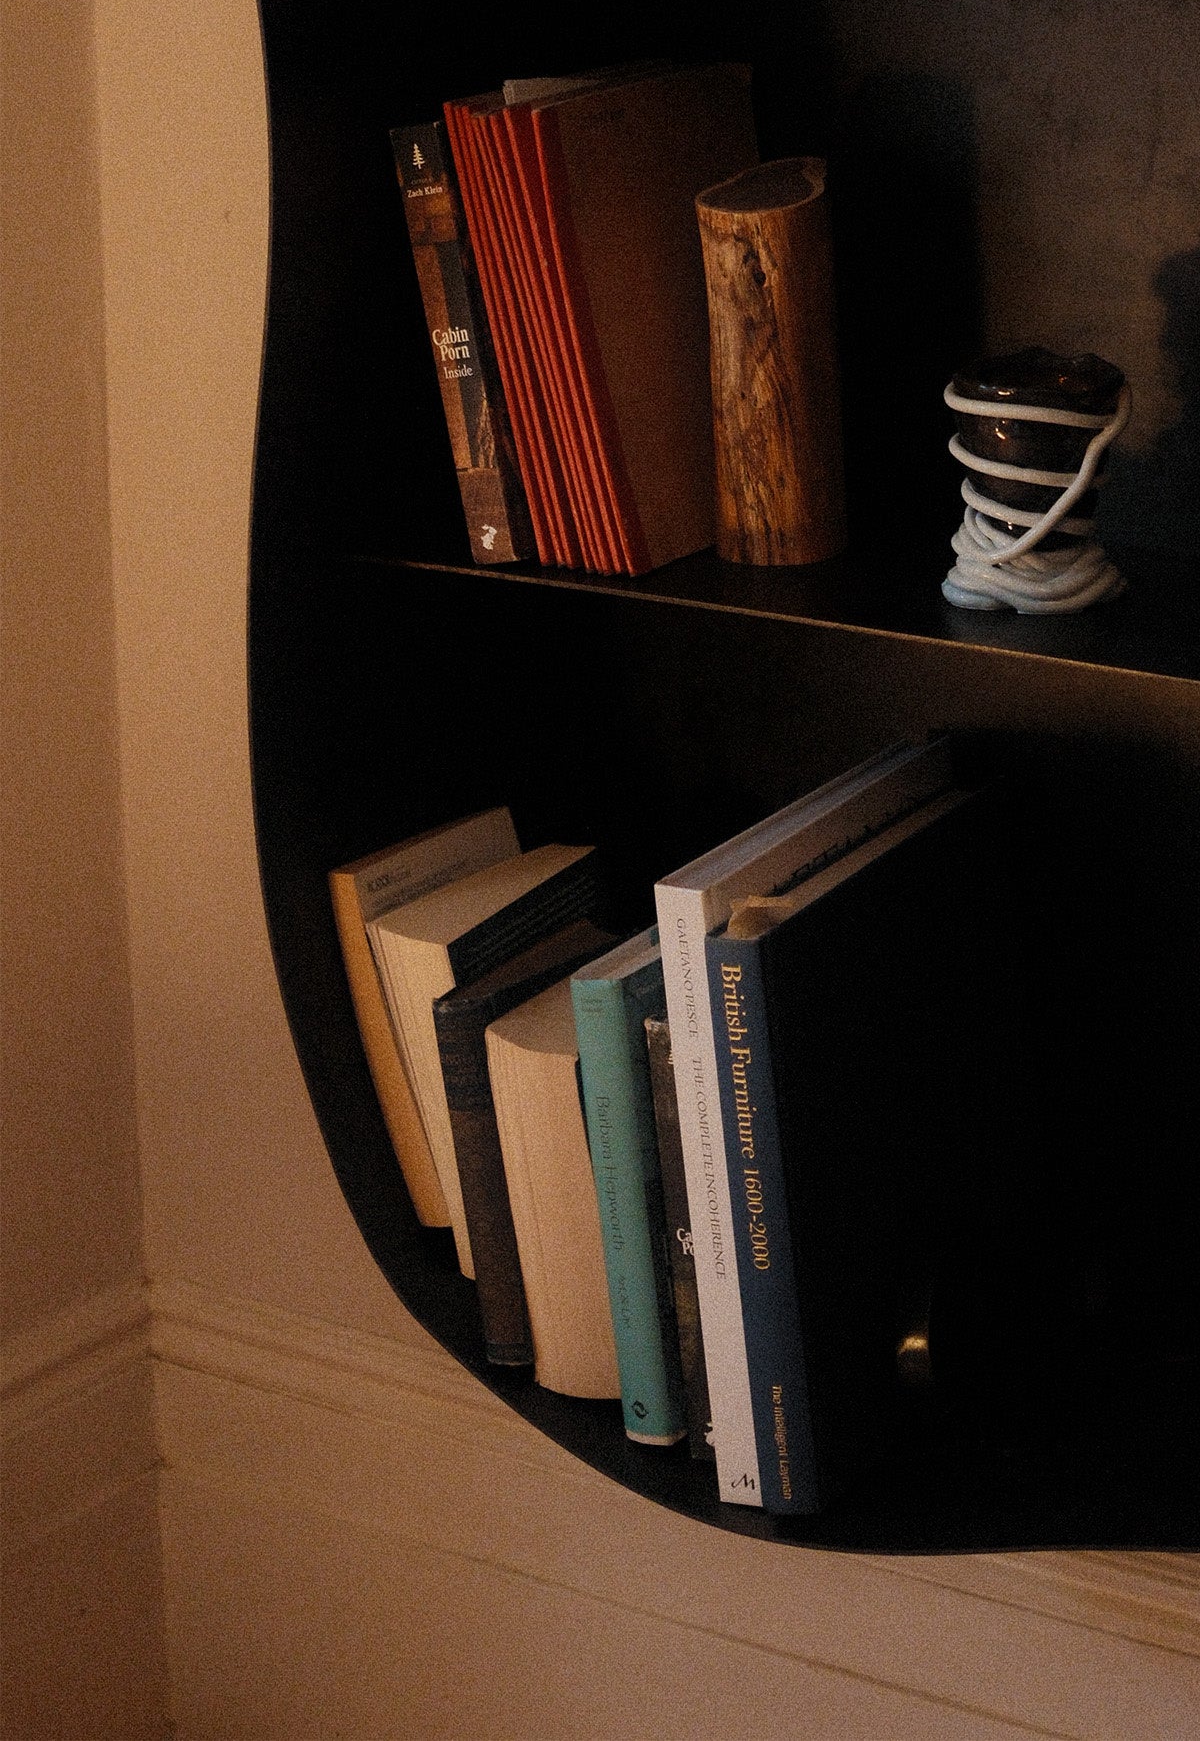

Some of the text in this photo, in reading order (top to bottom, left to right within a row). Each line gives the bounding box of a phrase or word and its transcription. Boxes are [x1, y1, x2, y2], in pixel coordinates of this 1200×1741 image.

[432, 326, 470, 346] Cabin
[439, 345, 470, 361] Porn
[443, 364, 474, 379] Inside
[676, 918, 726, 1280] GAETANO PESCE THE COMPLETE INCOHERENCE
[720, 962, 771, 1270] British Furniture 1600-2000
[596, 1096, 625, 1251] Barbara Hepworth
[771, 1384, 793, 1500] The Intelligent Layman
